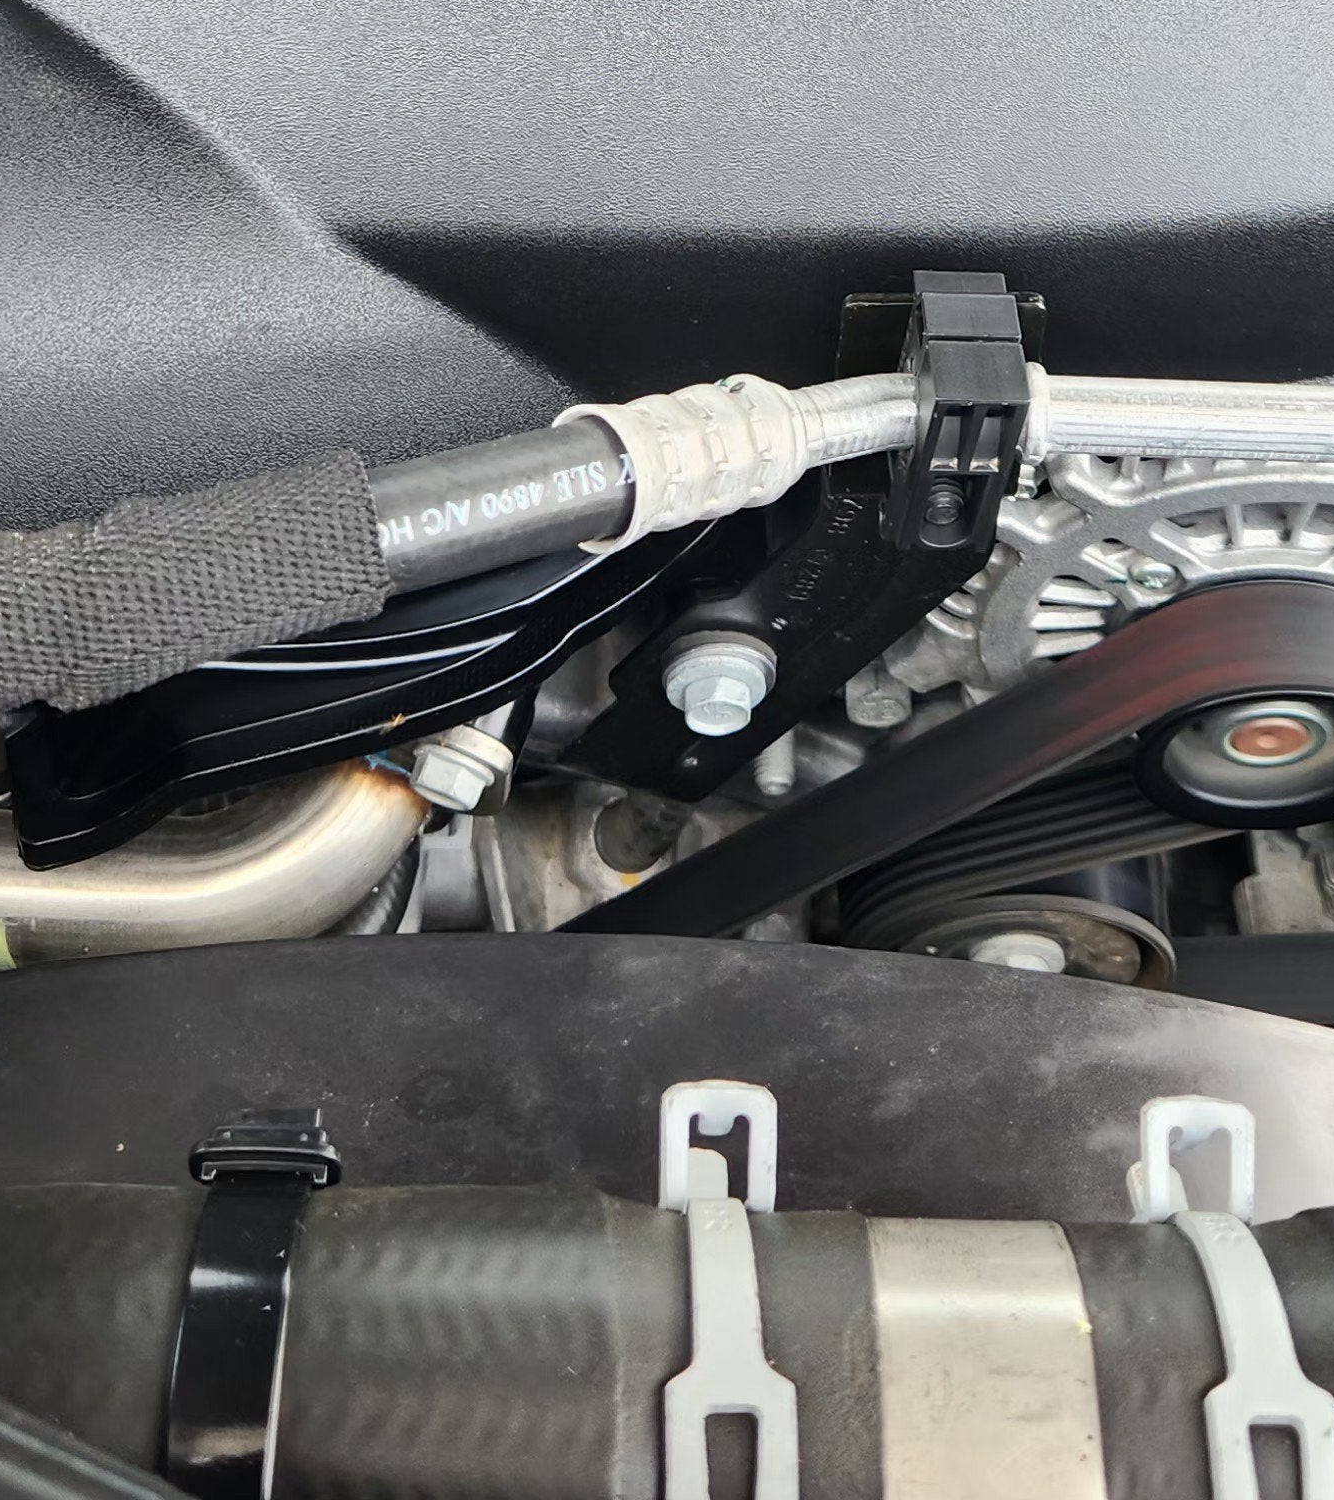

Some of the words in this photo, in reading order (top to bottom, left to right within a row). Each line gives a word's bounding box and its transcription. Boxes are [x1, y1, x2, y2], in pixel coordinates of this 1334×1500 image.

[480, 481, 545, 519] 4890
[553, 459, 606, 504] SLE
[420, 498, 472, 537] A/C
